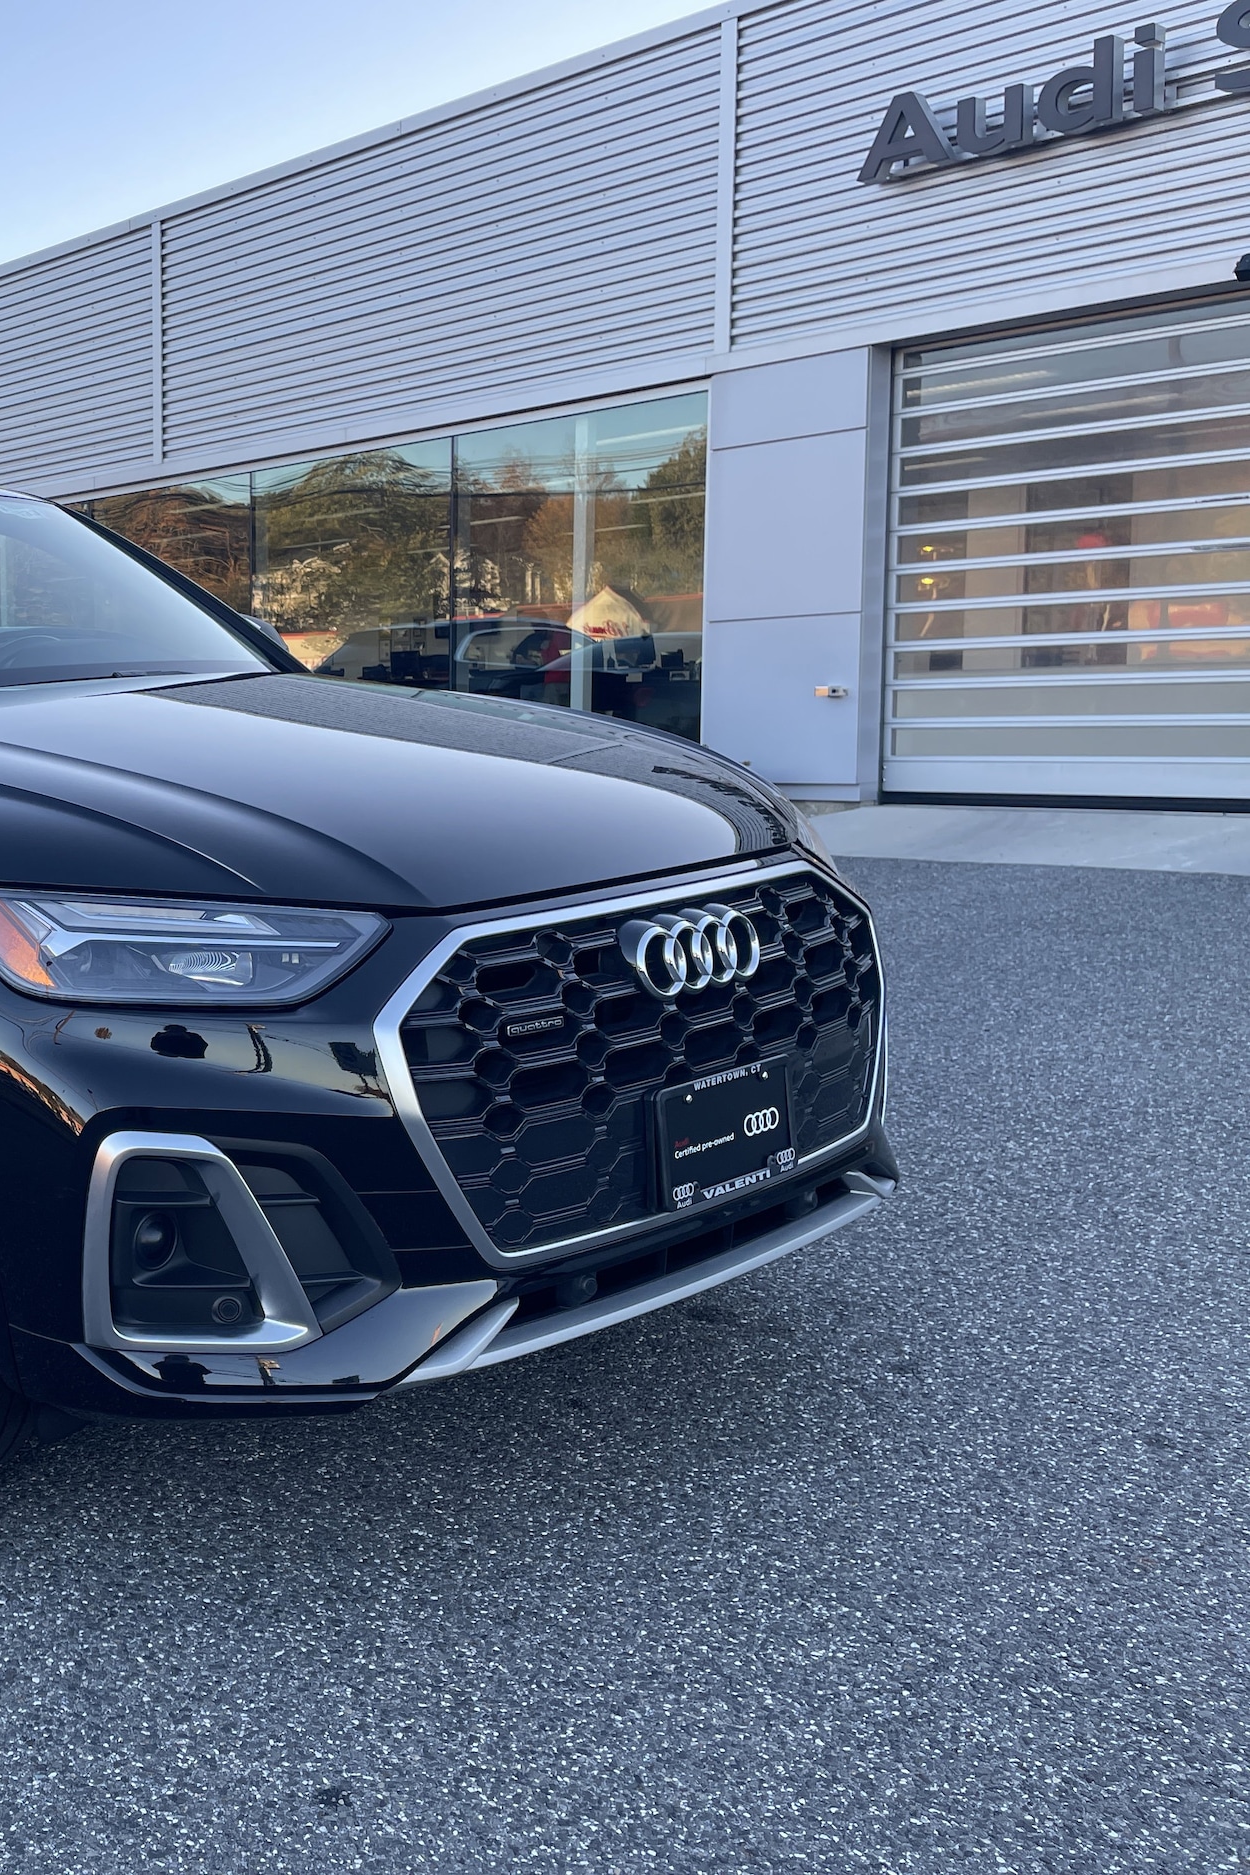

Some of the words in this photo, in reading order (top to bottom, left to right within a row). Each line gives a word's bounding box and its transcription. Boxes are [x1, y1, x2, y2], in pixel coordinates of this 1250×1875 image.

[857, 22, 1166, 185] Audi
[510, 1018, 563, 1035] quattro
[751, 1063, 762, 1075] CT
[674, 1137, 690, 1149] Audi
[674, 1143, 701, 1159] Certified
[702, 1131, 735, 1152] pre-owned
[780, 1162, 794, 1173] Audi
[702, 1169, 771, 1200] VALENTI
[676, 1197, 693, 1210] Audi
